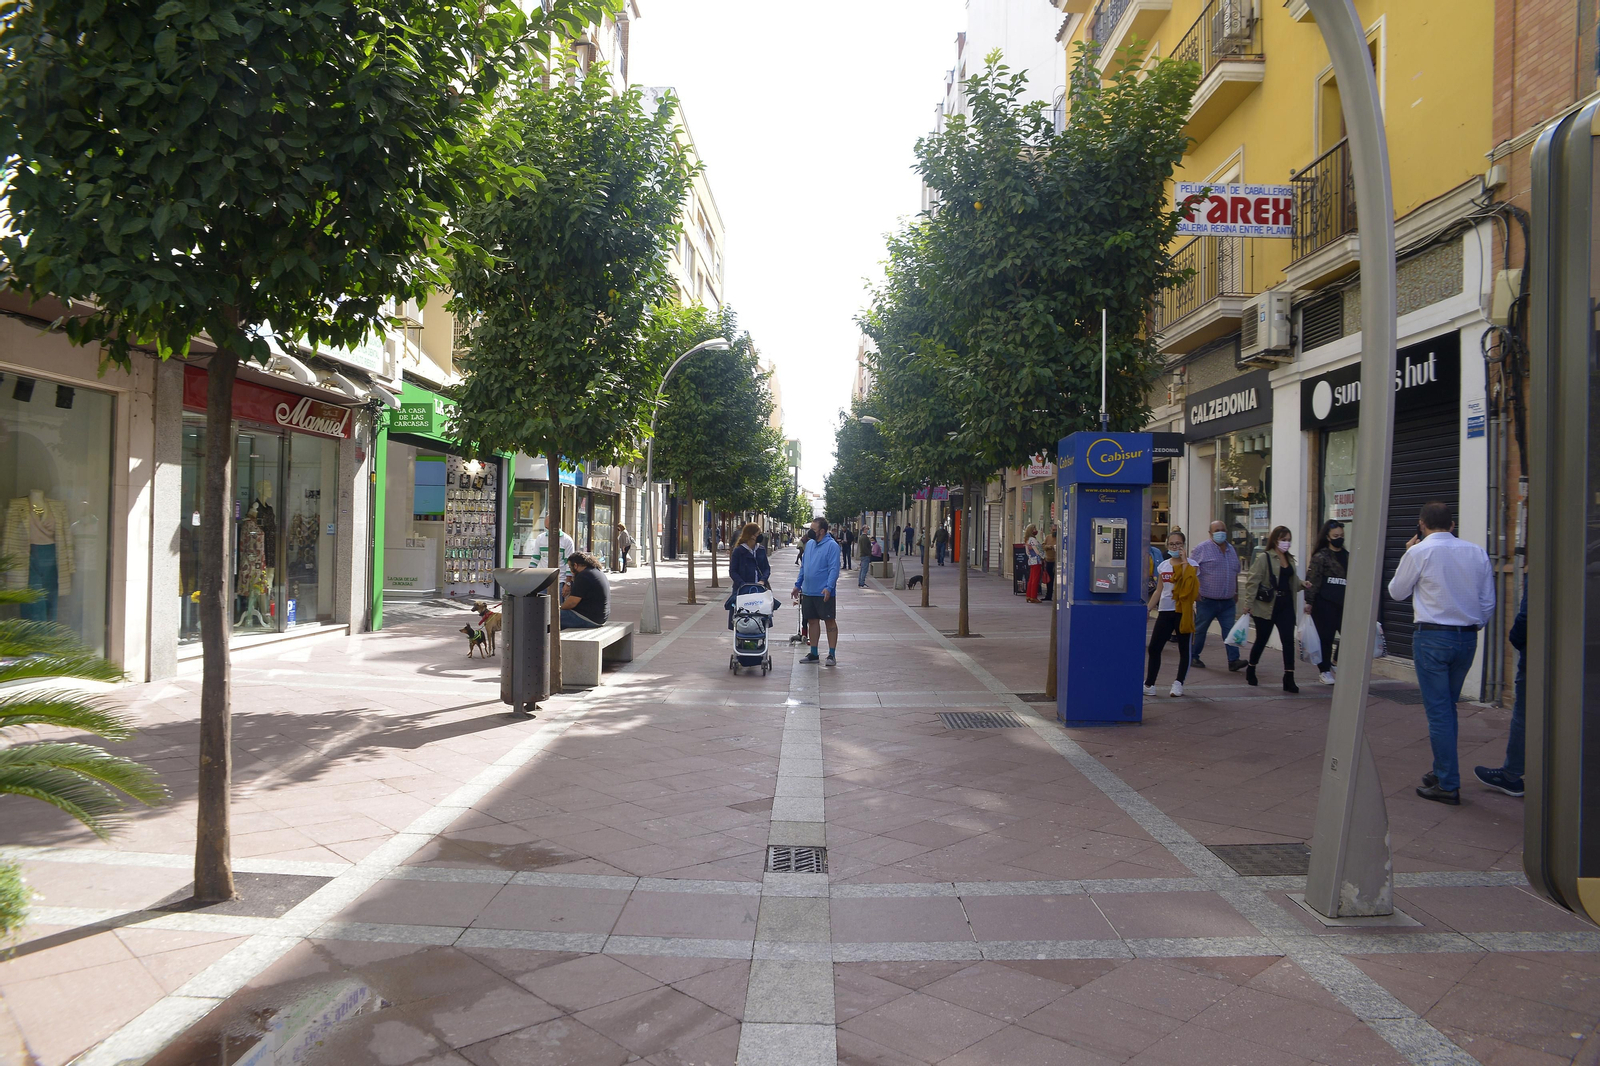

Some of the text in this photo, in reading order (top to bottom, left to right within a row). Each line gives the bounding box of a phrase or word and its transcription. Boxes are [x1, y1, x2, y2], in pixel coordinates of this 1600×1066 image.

[1230, 186, 1241, 195] DE
[1244, 187, 1293, 196] CABALLEROS
[1211, 225, 1237, 233] REGINA
[1240, 226, 1264, 234] ENTRE
[1404, 352, 1437, 388] hut
[1191, 388, 1258, 425] CALZEDONIA
[276, 396, 351, 438] Manuel
[1060, 455, 1074, 469] Cabisur
[1100, 449, 1143, 463] Cabisur
